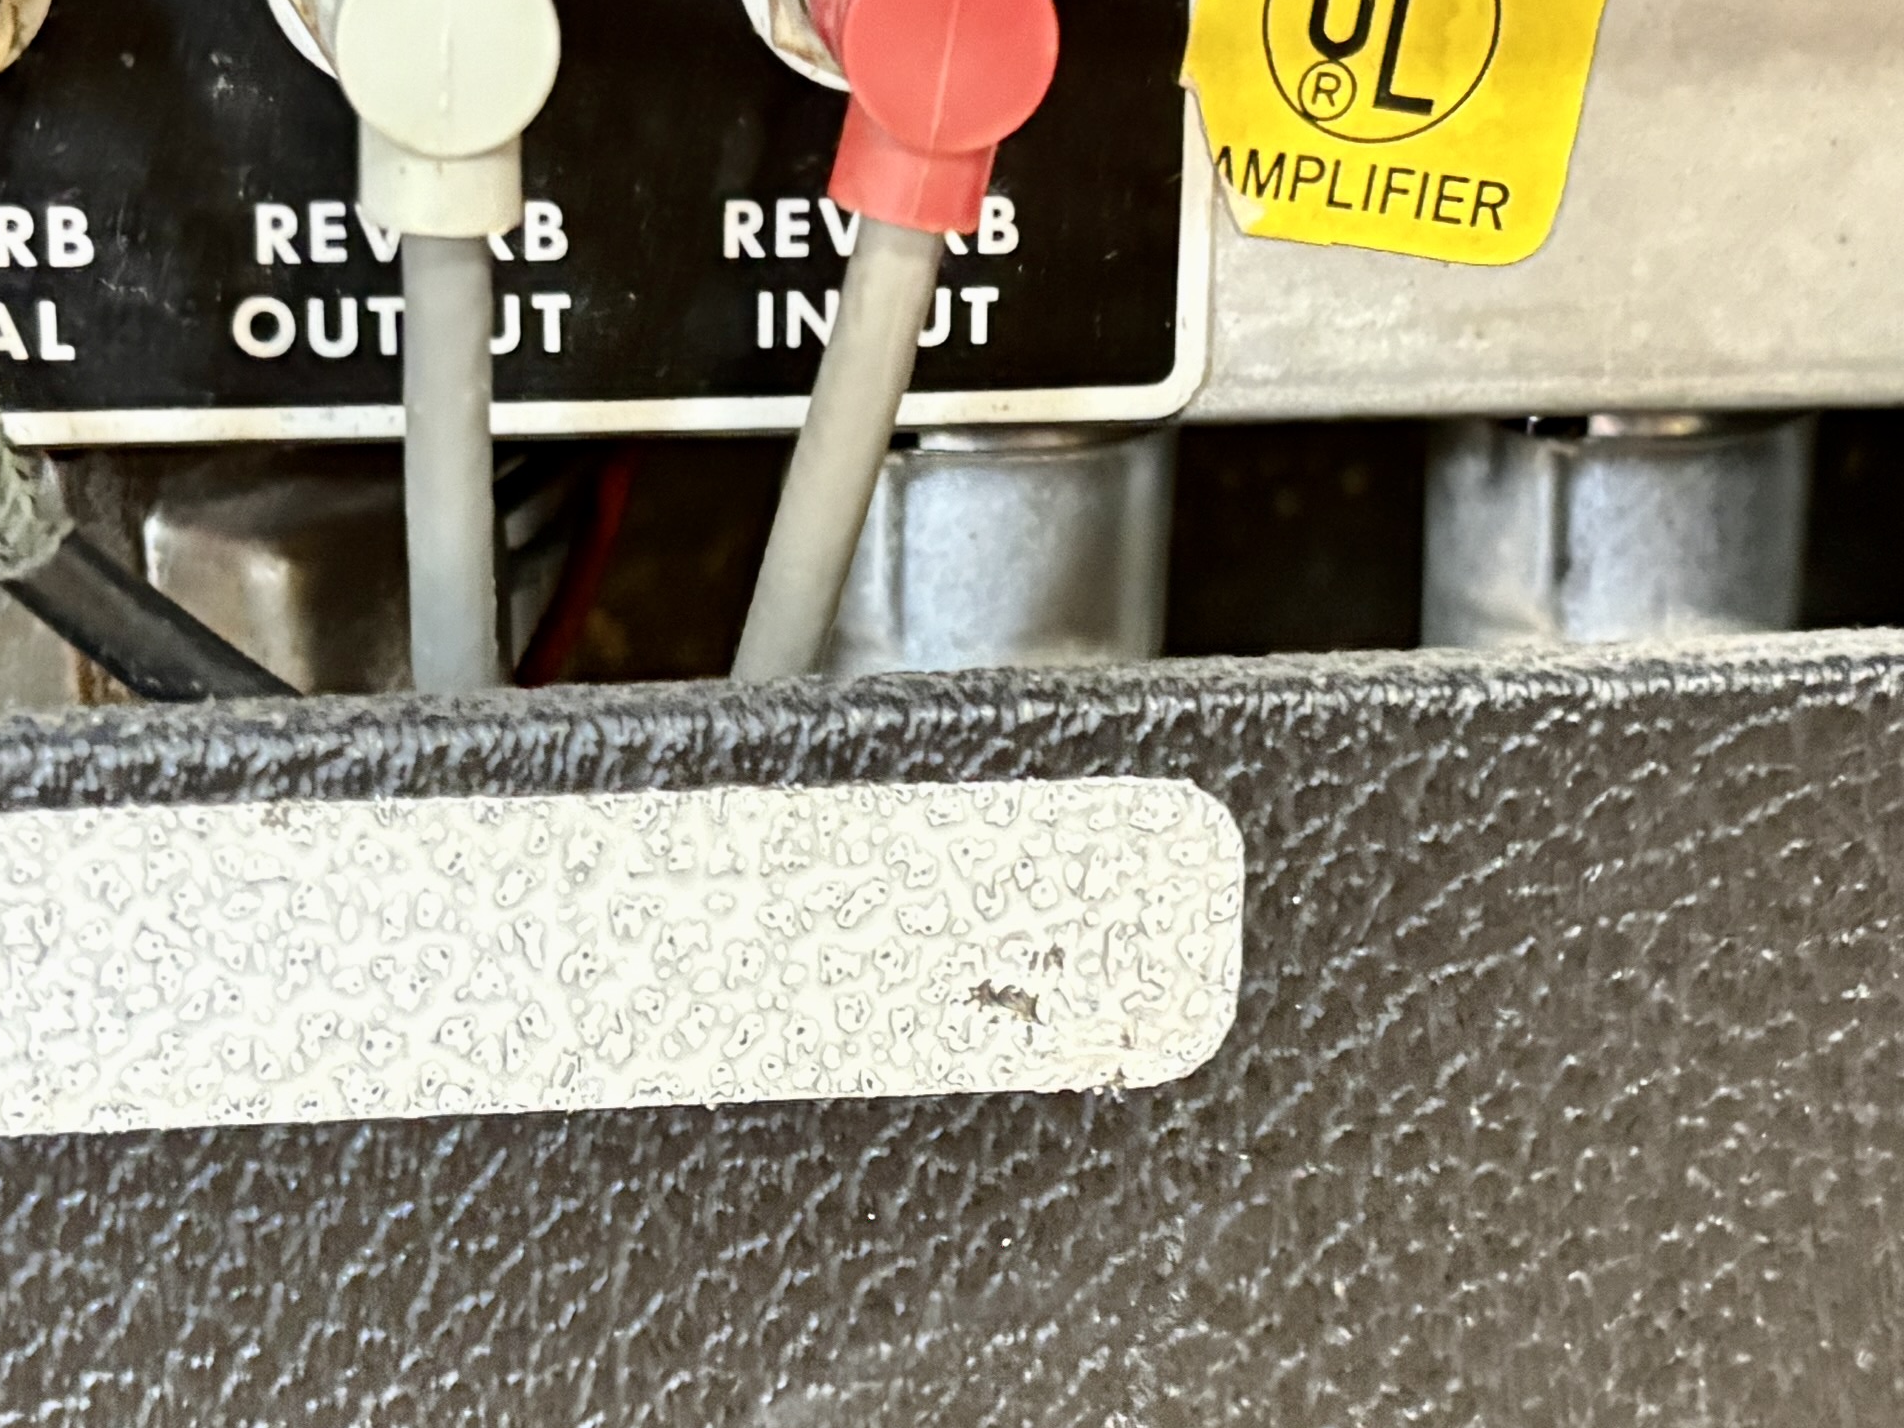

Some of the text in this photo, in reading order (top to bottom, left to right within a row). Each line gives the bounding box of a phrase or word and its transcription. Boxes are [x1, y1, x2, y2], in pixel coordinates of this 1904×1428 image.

[254, 199, 569, 265] REVB
[723, 195, 1020, 259] REVB
[232, 292, 571, 359] OUTUT
[757, 285, 999, 349] INUT
